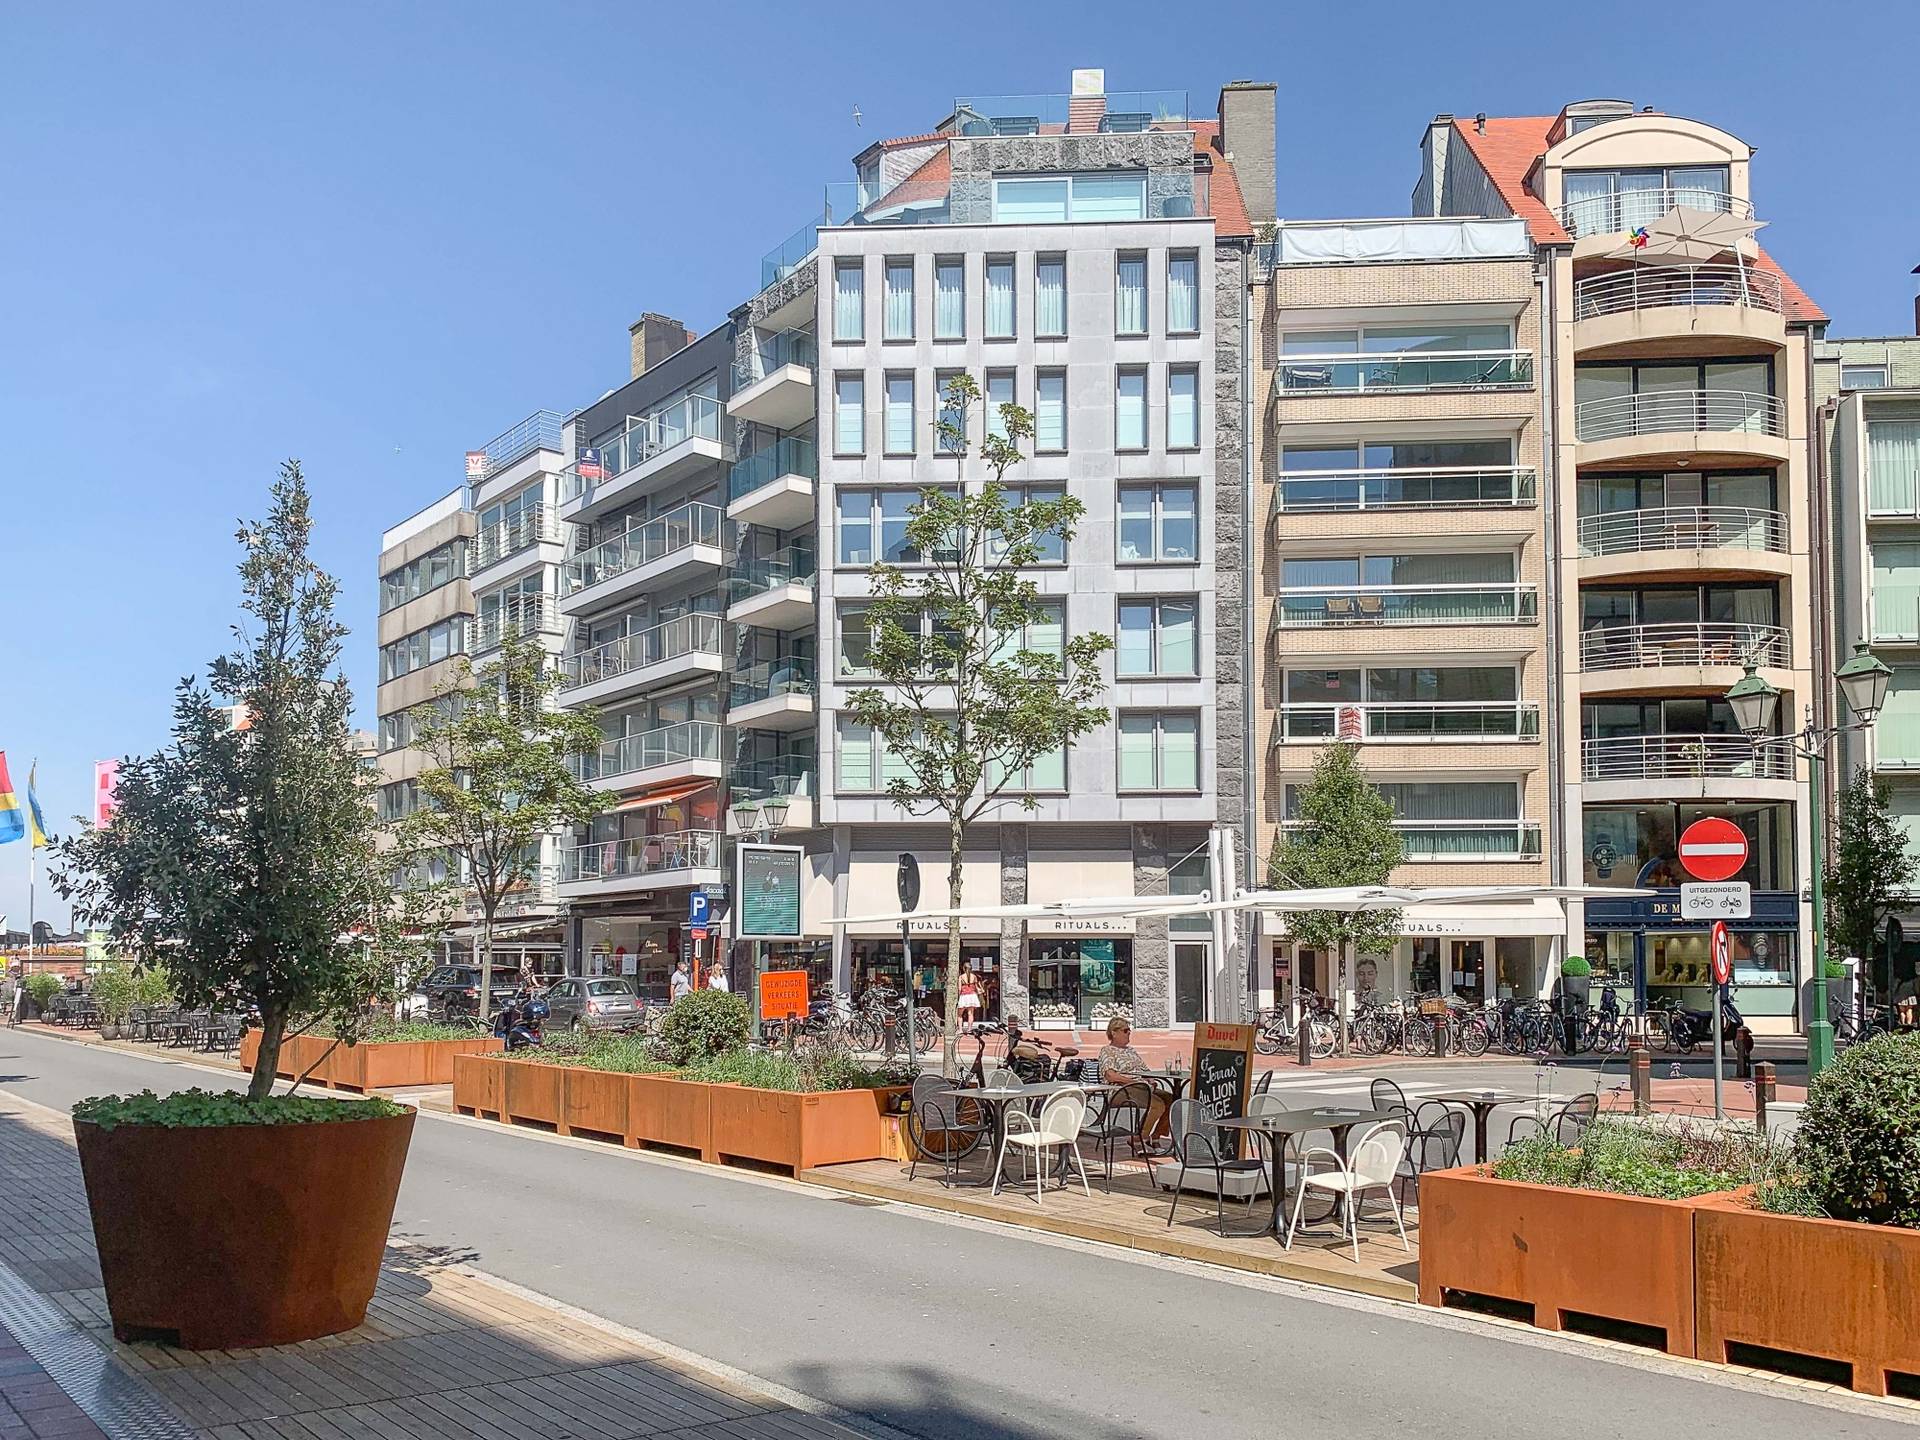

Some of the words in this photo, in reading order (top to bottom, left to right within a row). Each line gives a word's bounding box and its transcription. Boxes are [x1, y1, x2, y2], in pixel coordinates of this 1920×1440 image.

[1689, 886, 1742, 894] UITGEZONDERD
[693, 896, 706, 916] P
[1653, 903, 1668, 914] DE
[1671, 903, 1681, 914] M
[1055, 921, 1127, 930] RITUALS...
[771, 1002, 798, 1010] SITUATIE
[1207, 1025, 1240, 1041] Duvel
[1212, 1080, 1238, 1102] LION
